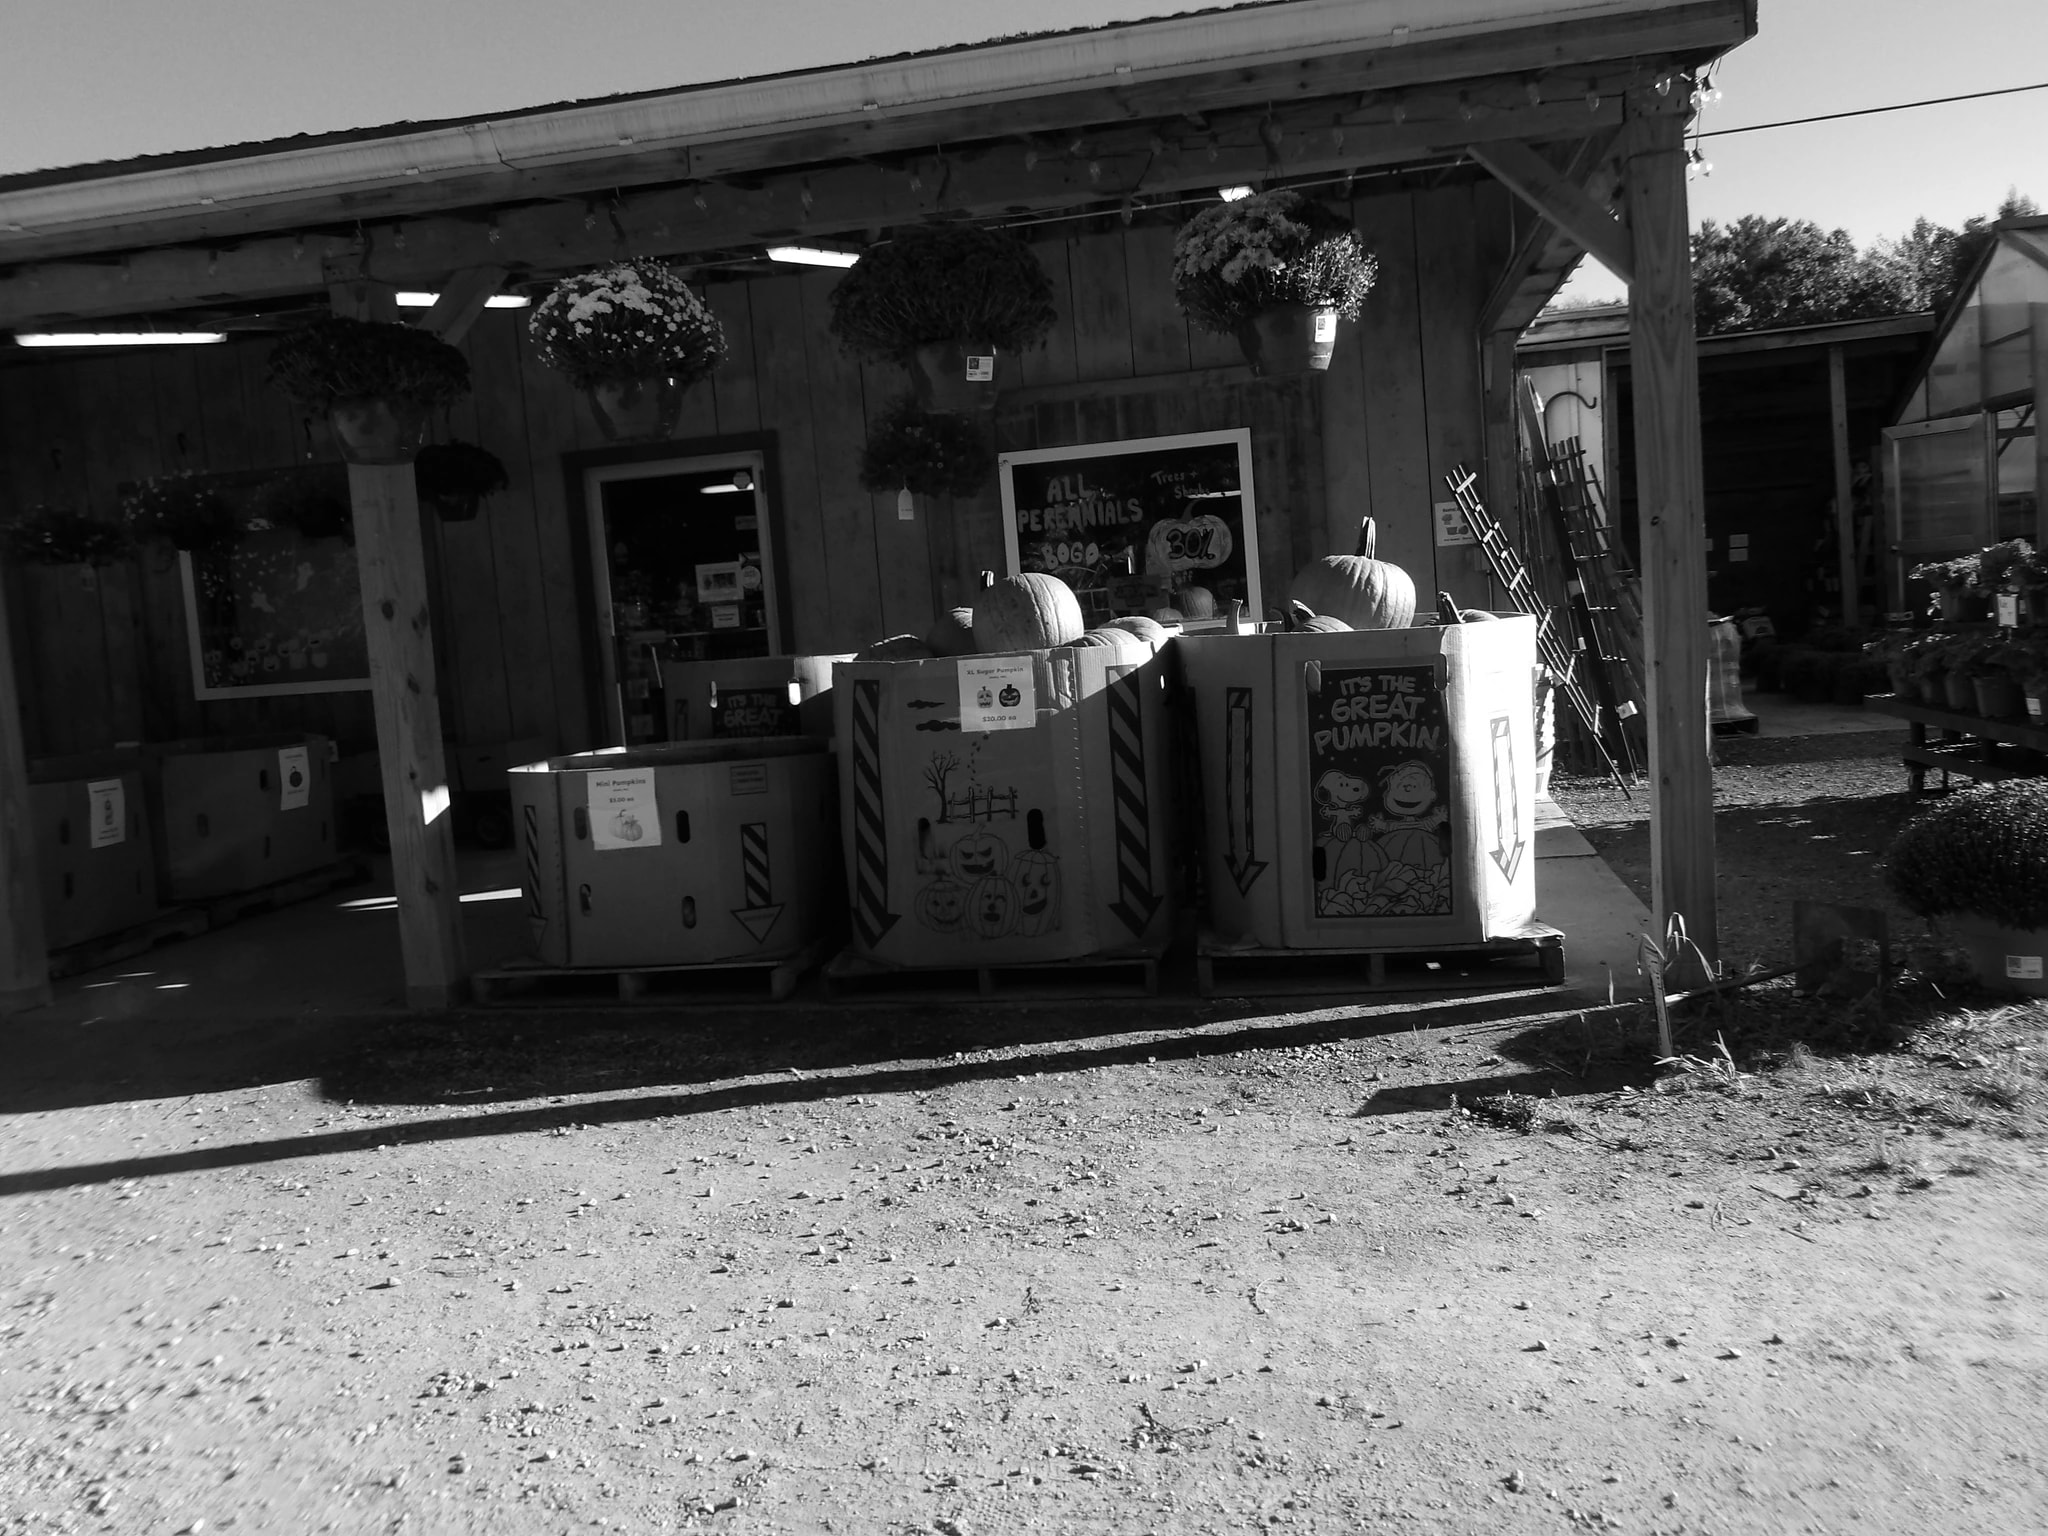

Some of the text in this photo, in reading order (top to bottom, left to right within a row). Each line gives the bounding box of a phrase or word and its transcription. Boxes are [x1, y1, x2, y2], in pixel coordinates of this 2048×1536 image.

[1046, 473, 1094, 503] ALL
[1150, 470, 1185, 485] Trees
[1018, 497, 1143, 534] PERENNIALS
[1041, 541, 1100, 570] BOGO
[1166, 527, 1215, 560] 30%
[997, 666, 1024, 674] Pumpkin
[1340, 675, 1416, 696] IT'S THE
[752, 693, 777, 707] THE
[1331, 692, 1425, 722] GREAT
[723, 708, 785, 727] GREAT
[1314, 721, 1440, 755] PUMPKIN
[612, 778, 646, 788] Pumpkins
